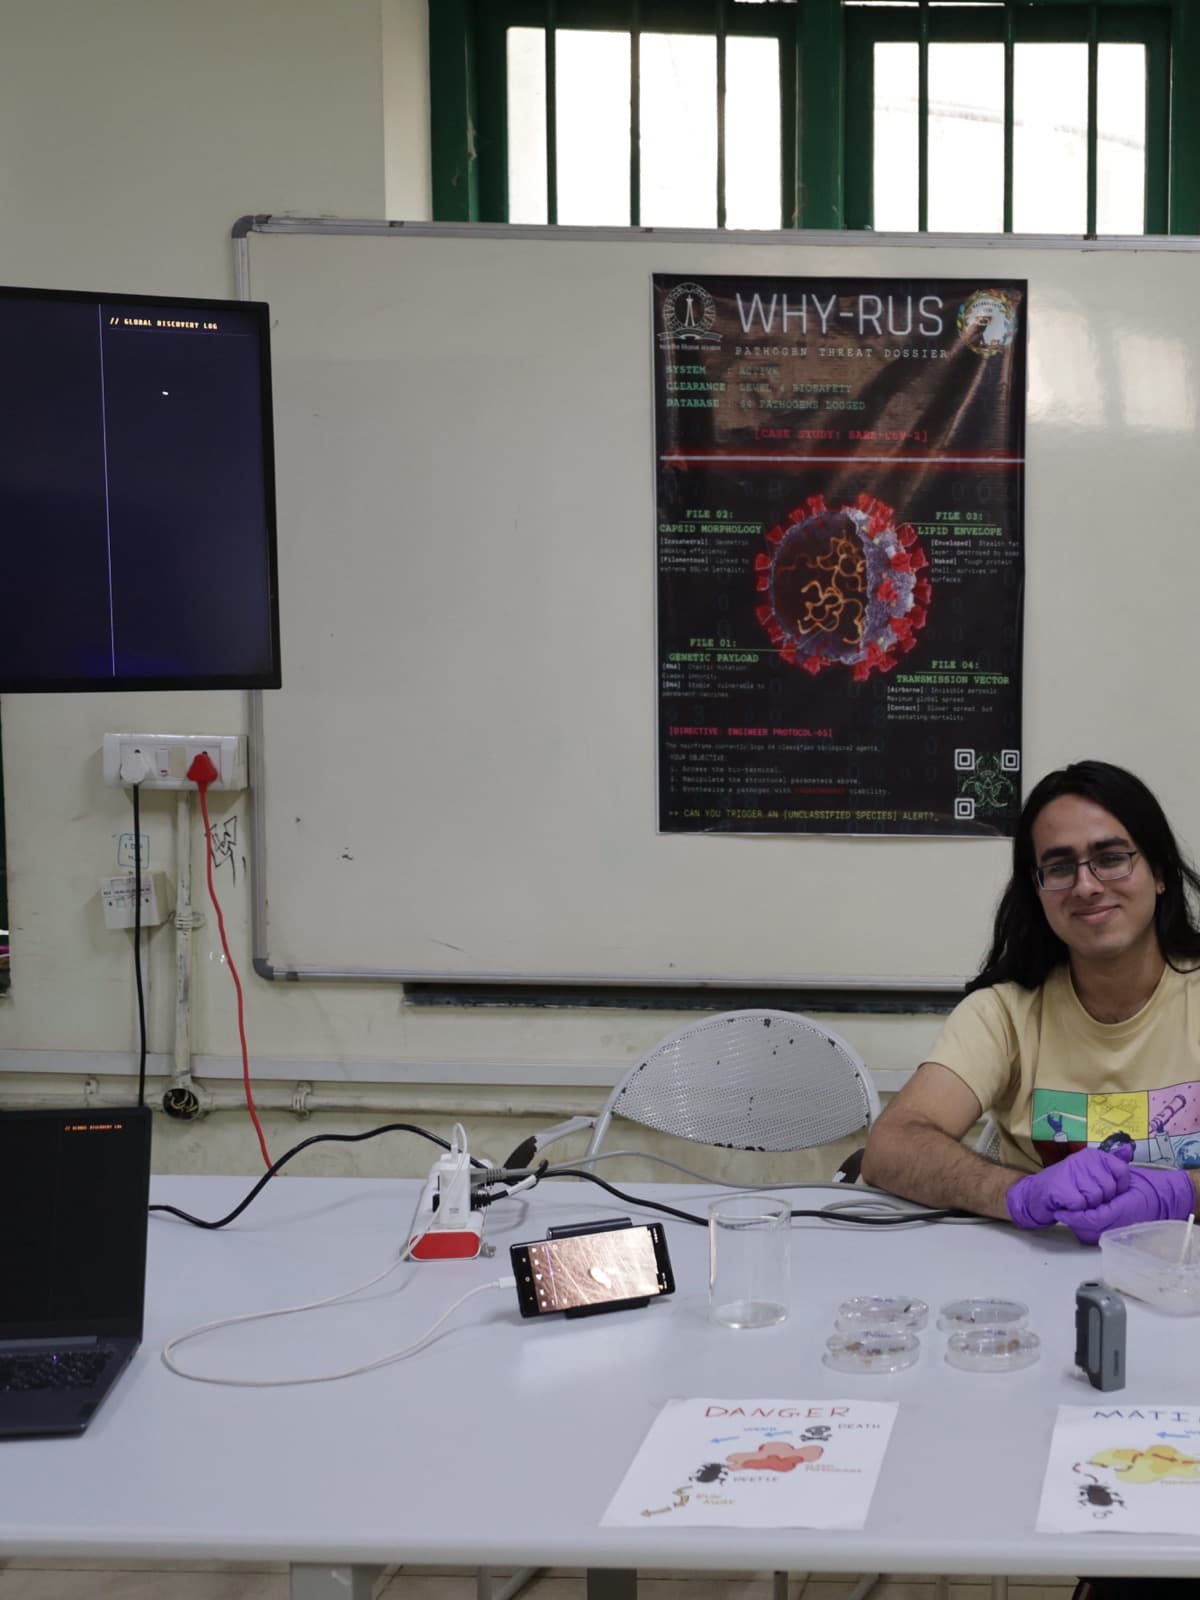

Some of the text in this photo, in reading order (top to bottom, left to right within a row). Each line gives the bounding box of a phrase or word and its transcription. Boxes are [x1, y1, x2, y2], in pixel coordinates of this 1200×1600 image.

[736, 293, 944, 336] WHY-RUS
[124, 318, 152, 327] GLOBAL
[157, 321, 199, 329] DISCOVERY
[735, 346, 948, 358] PATHOGEN THREAT DOSSIER
[666, 365, 706, 374] SYSTEM
[666, 398, 719, 408] DATABASE
[686, 509, 710, 518] FILE
[936, 512, 961, 520] FILE
[660, 524, 761, 534] CAPSID MORPHOLOGY
[918, 527, 1002, 536] LIPID ENVELOPE
[690, 638, 714, 647] FILE
[669, 653, 760, 662] GENETIC PAYLOAD
[931, 660, 956, 669] FILE
[897, 675, 1009, 684] TRANSMISSION VECTOR
[683, 809, 700, 817] CAN
[705, 809, 721, 817] YOU
[726, 809, 763, 818] TRIGGER
[768, 810, 779, 818] AN
[705, 1406, 850, 1418] DANGER
